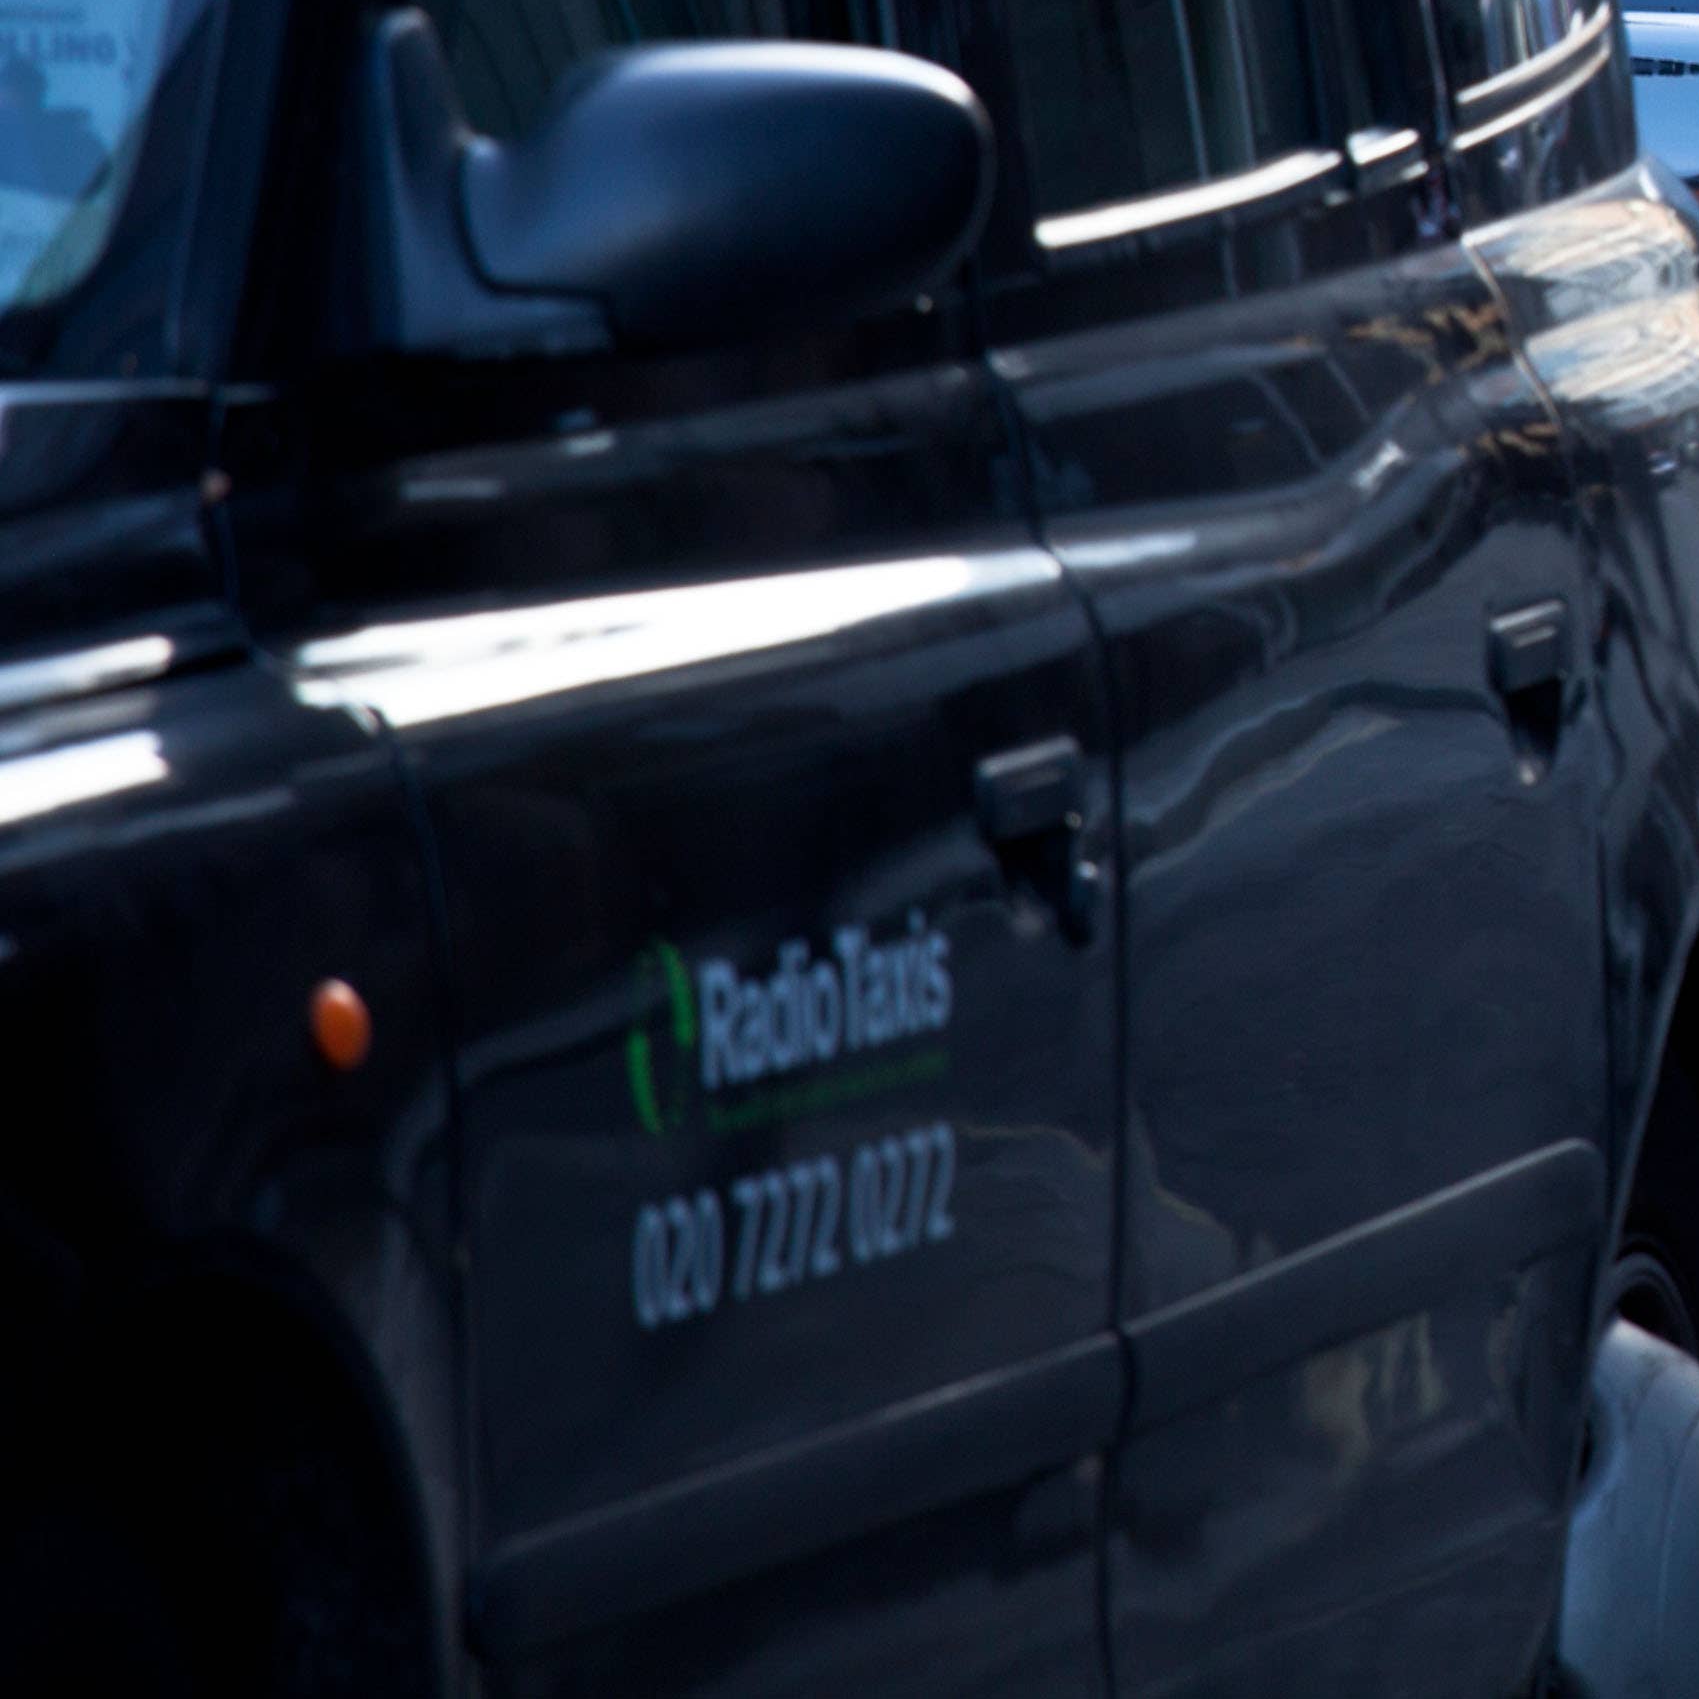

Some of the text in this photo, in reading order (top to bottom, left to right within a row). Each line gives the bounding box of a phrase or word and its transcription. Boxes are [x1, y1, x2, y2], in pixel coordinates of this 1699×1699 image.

[634, 1123, 957, 1329] 020 7272 0272
